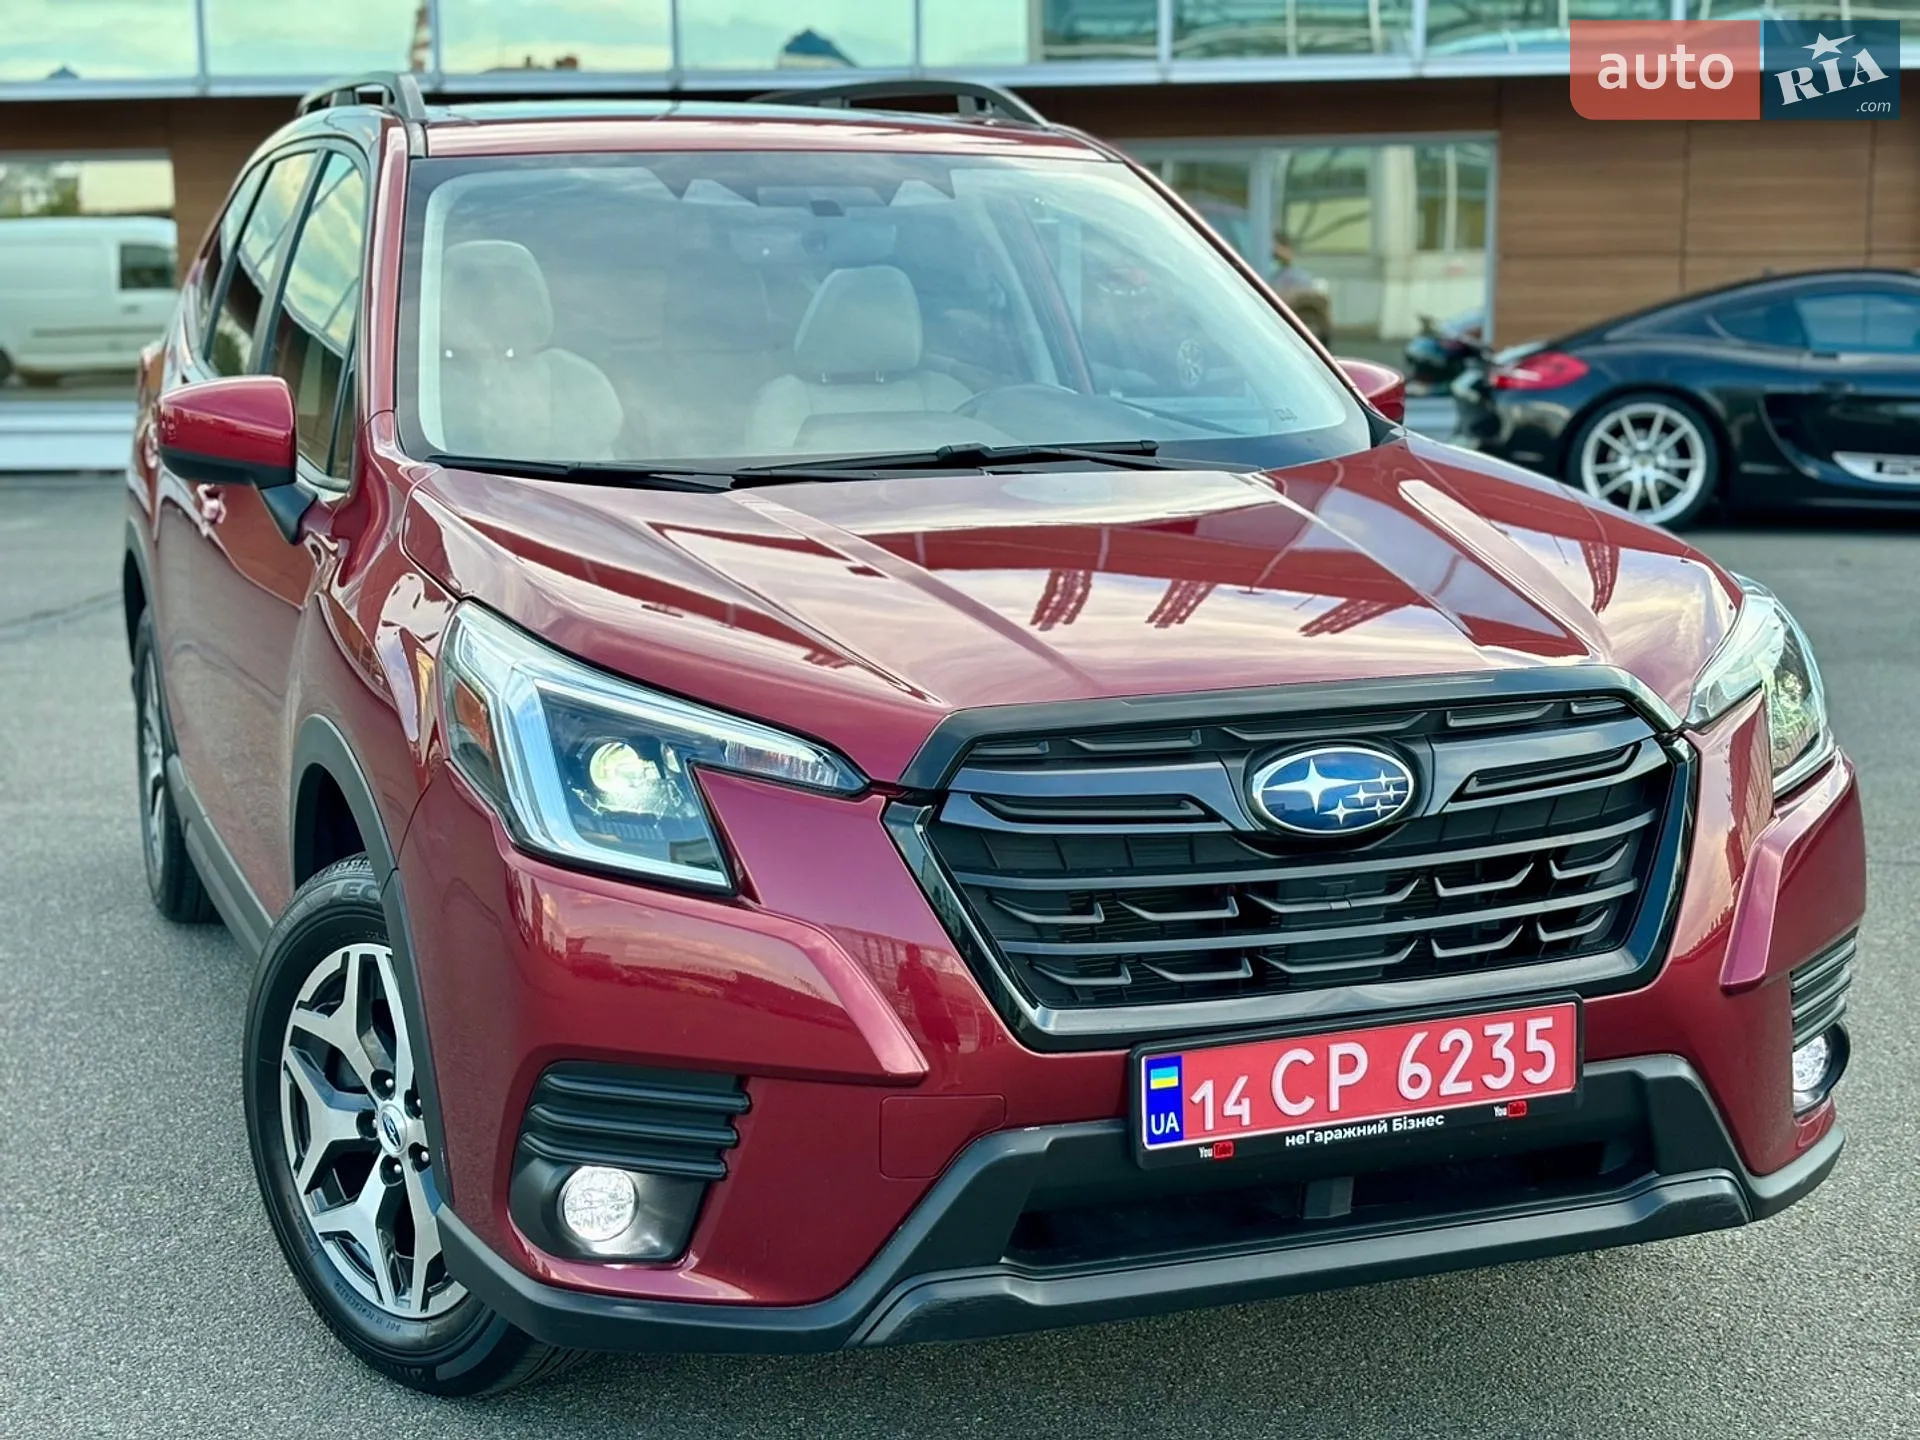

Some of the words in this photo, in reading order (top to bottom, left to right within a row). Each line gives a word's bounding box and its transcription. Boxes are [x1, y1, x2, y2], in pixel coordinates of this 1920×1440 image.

[1190, 1075, 1250, 1131] 14
[1398, 1017, 1557, 1101] 6235
[1150, 1111, 1180, 1135] UA
[1285, 1120, 1388, 1147] неГаражний
[1392, 1114, 1445, 1132] Бізнес
